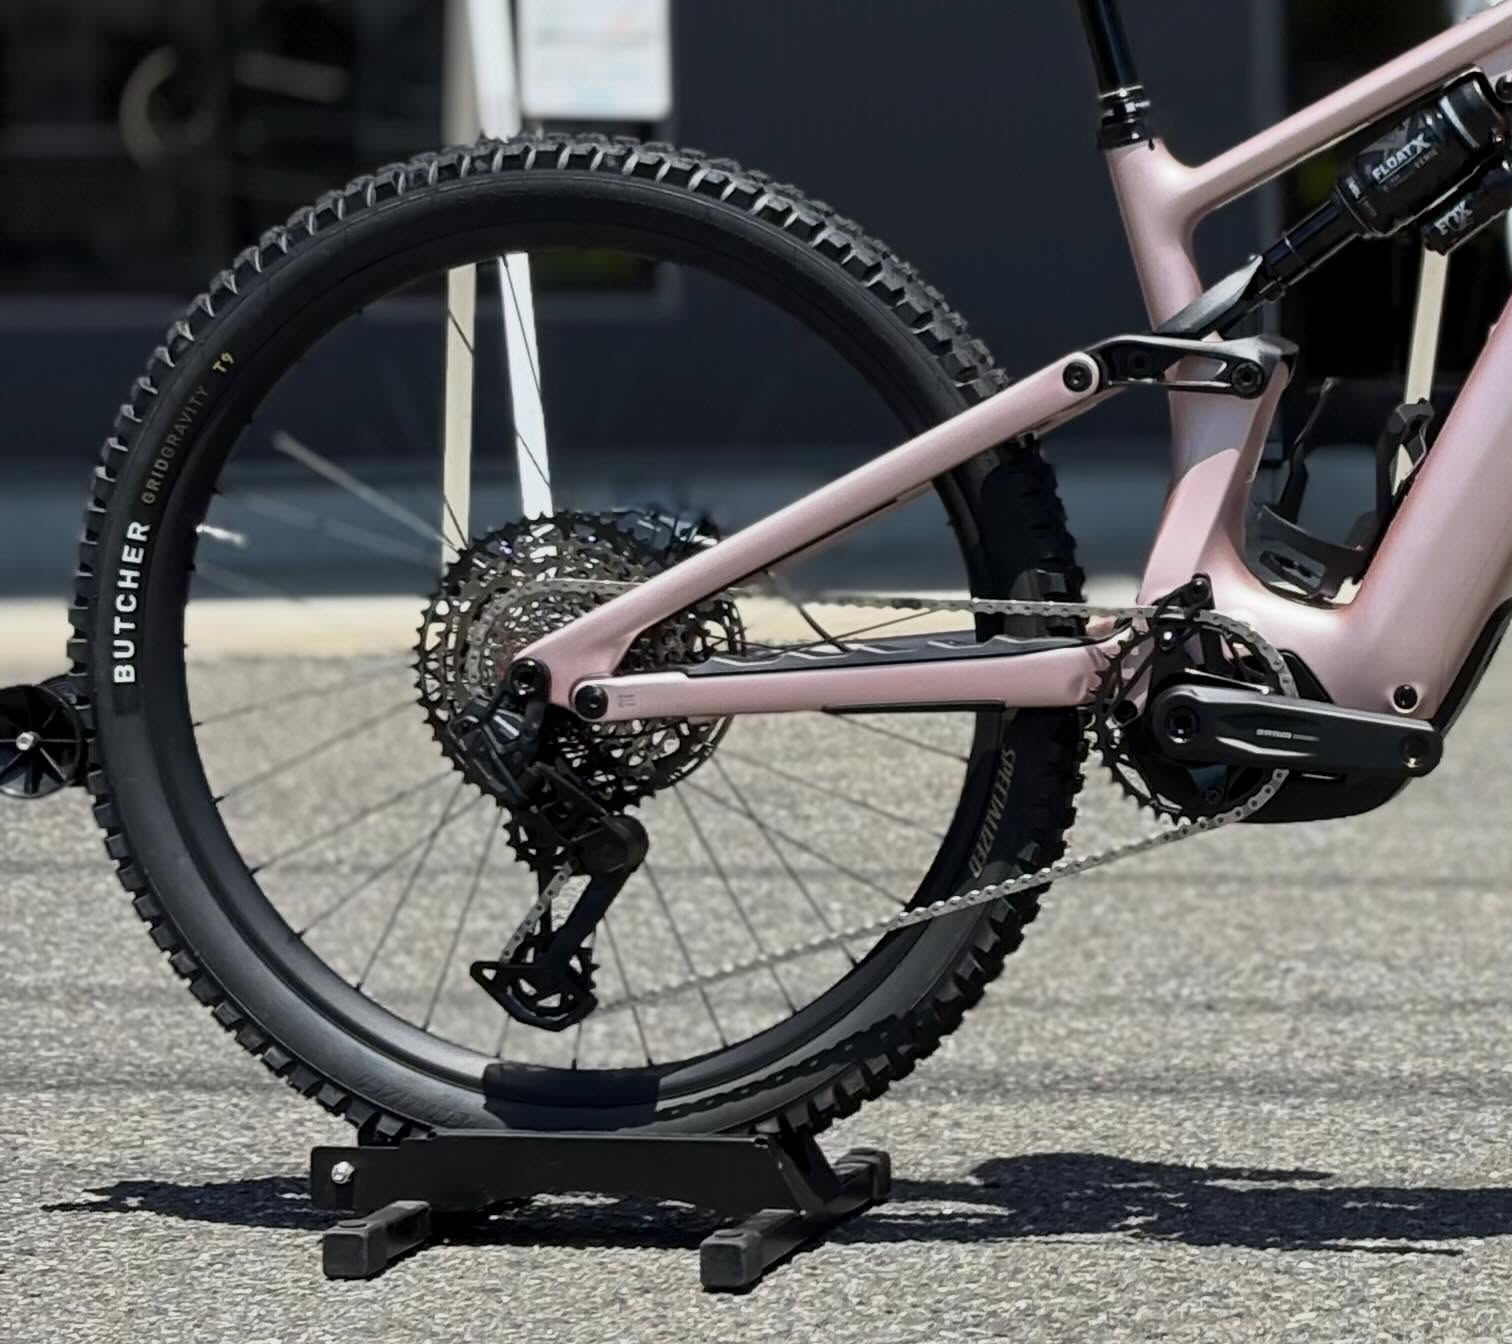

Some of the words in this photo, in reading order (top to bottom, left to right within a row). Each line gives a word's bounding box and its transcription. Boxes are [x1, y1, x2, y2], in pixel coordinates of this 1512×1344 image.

[113, 520, 151, 684] BUTCHER
[141, 386, 209, 505] GRIDGRAVITY
[212, 351, 234, 374] T9
[967, 747, 1016, 879] SPECIALIZED
